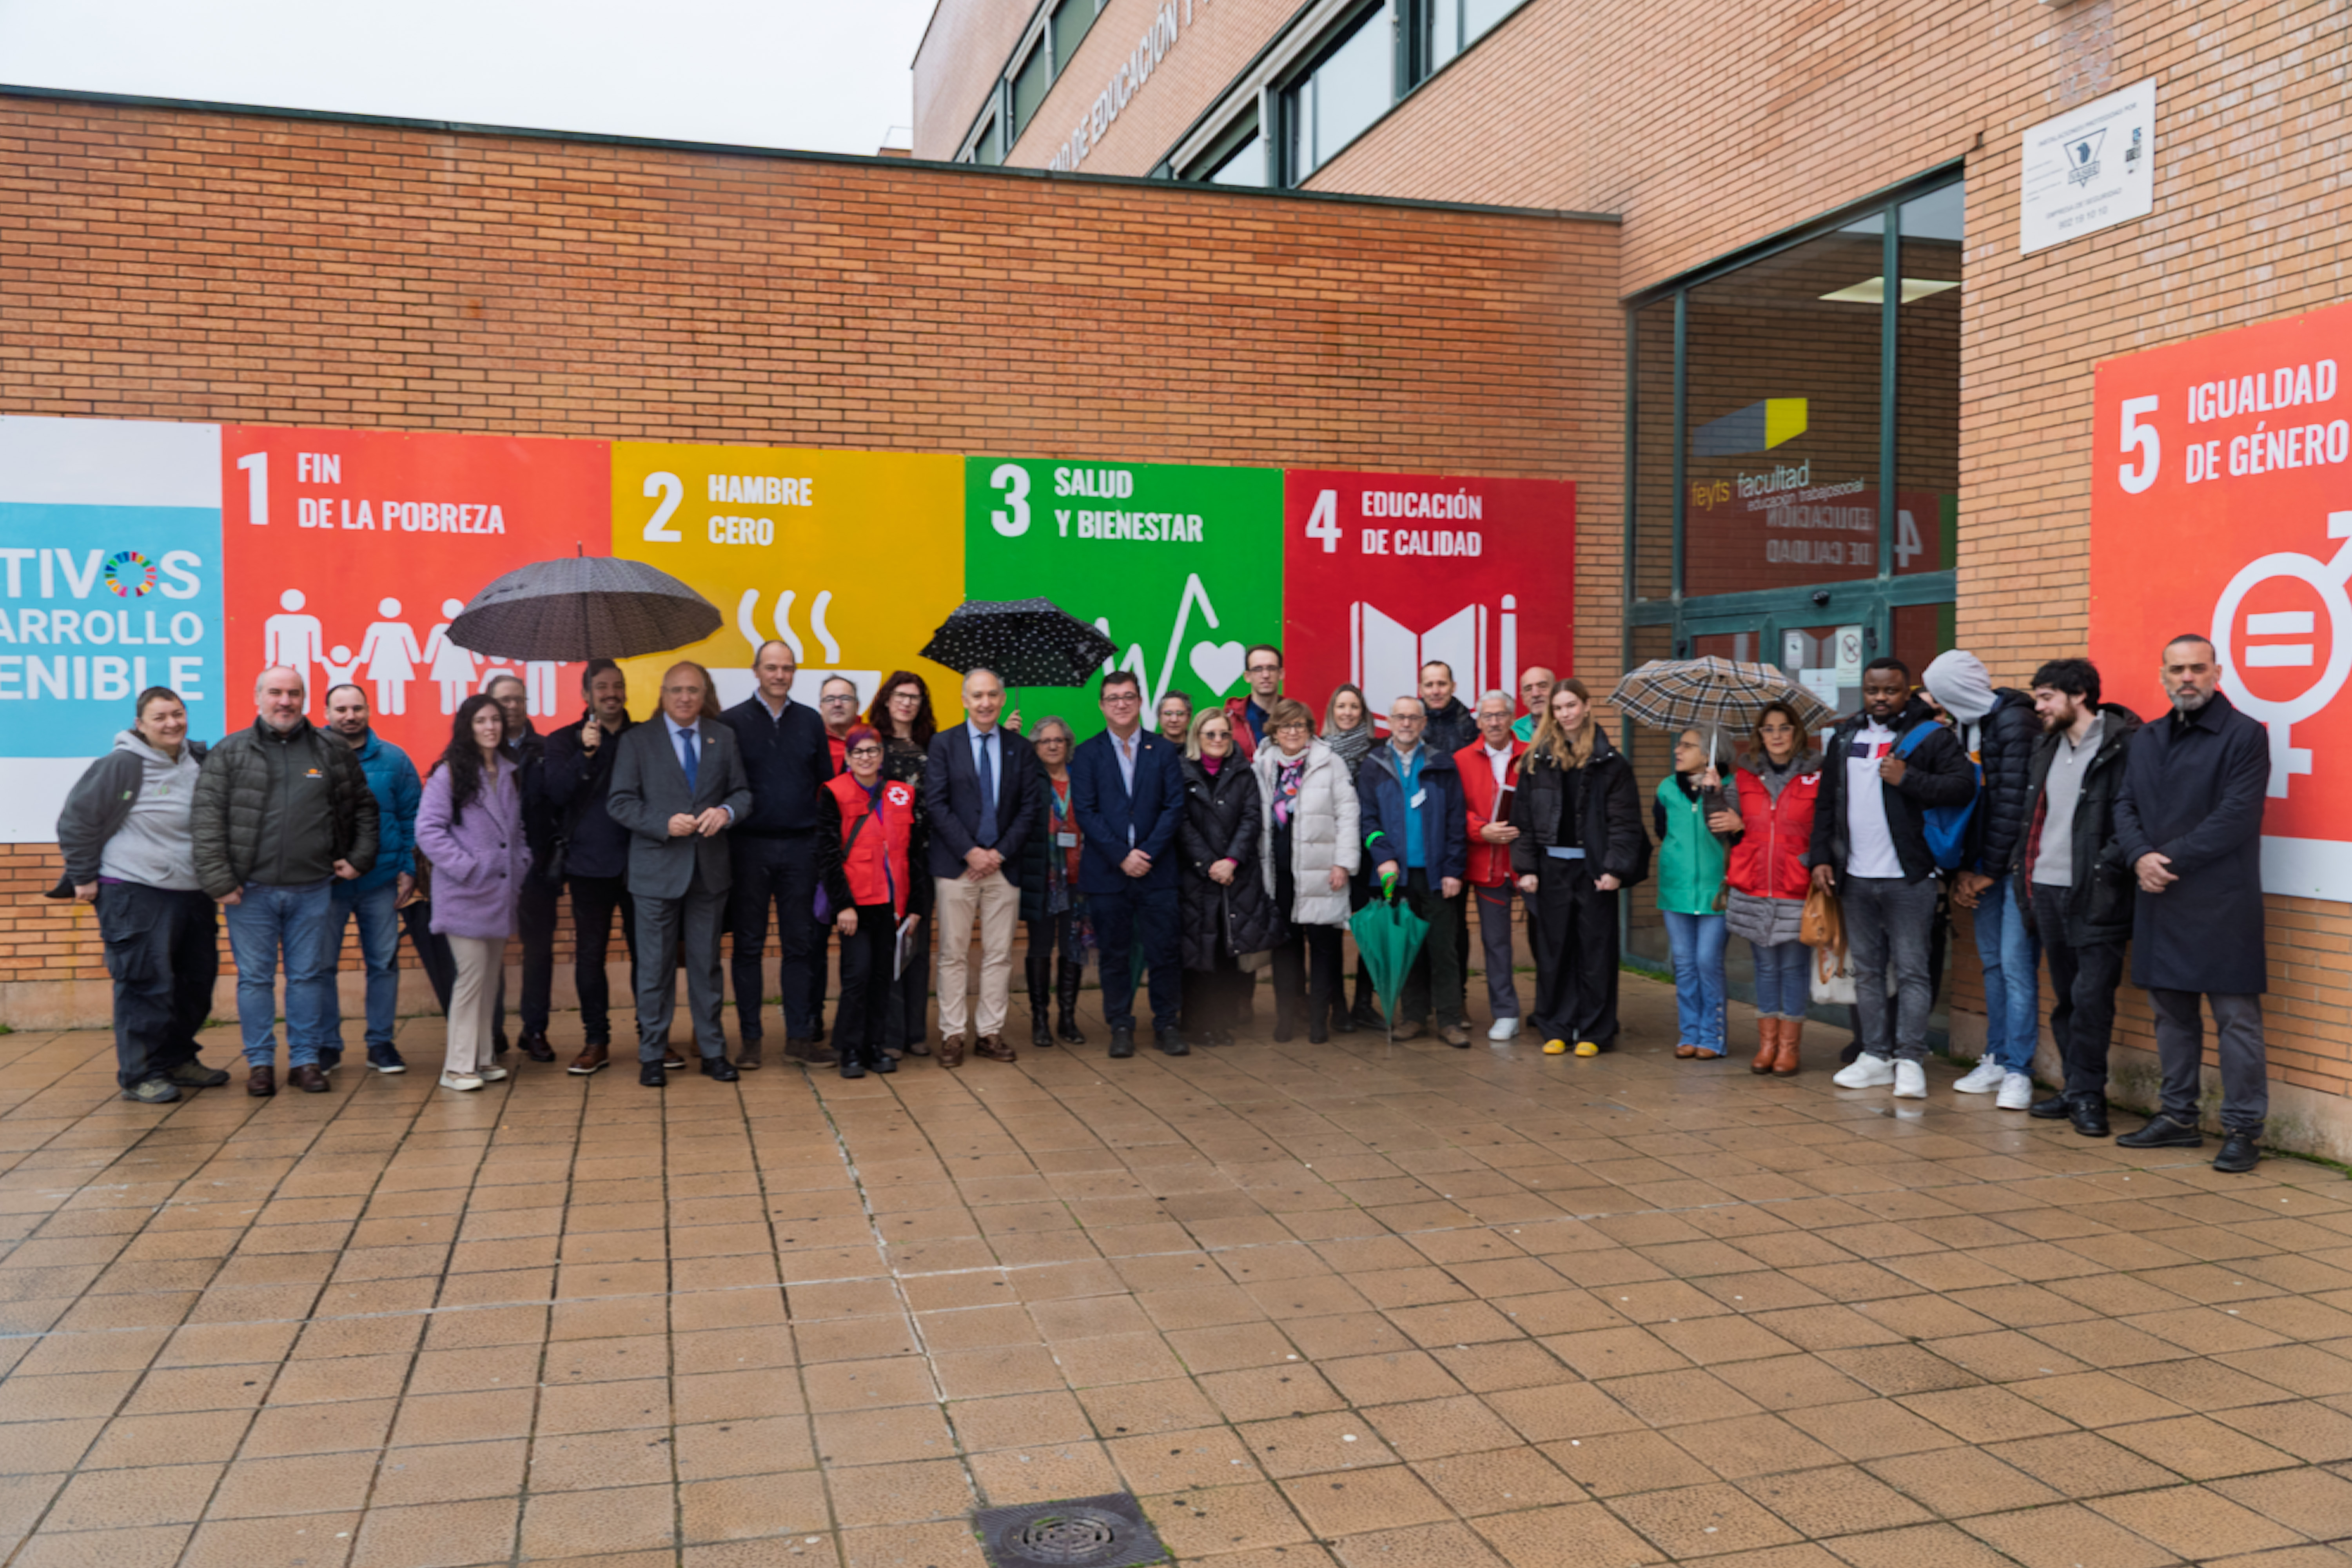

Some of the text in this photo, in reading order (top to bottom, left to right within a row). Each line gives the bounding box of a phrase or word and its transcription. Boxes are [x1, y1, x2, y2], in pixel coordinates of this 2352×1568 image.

[1092, 0, 1177, 144] EDUCACIÓN
[2188, 359, 2337, 424] IGUALDAD
[2118, 394, 2160, 494] 5
[2186, 419, 2350, 484] DE GÉNERO
[298, 452, 341, 484] FIN
[1054, 466, 1133, 498] SALUD
[1737, 458, 1809, 498] facultad
[237, 452, 269, 525] 1
[643, 471, 684, 543] 2
[708, 474, 813, 506] HAMBRE
[990, 463, 1031, 537] 3
[1361, 487, 1482, 520] EDUCACIÓN
[1692, 479, 1730, 512] feyts
[298, 498, 505, 534] DE LA POBREZA
[708, 516, 774, 546] CERO
[1054, 509, 1203, 542] Y BIENESTAR
[1305, 489, 1343, 553] 4
[1362, 529, 1482, 557] DE CALIDAD
